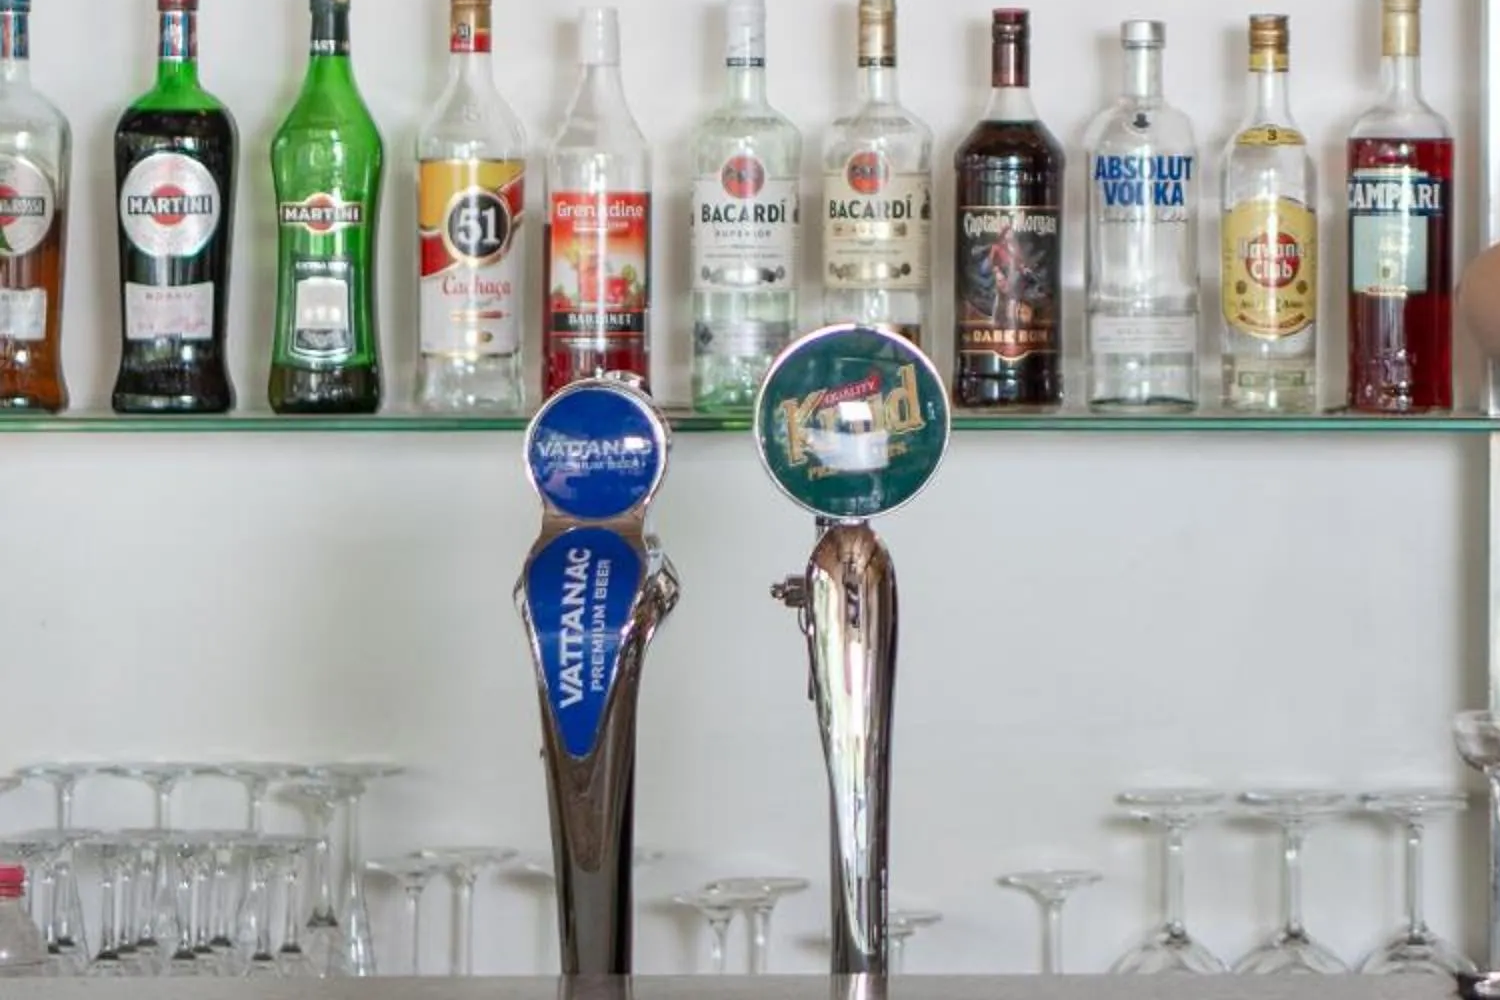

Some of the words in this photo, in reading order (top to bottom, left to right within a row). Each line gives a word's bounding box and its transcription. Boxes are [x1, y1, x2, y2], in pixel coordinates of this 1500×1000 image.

[1094, 154, 1193, 181] ABSOLUT
[129, 196, 212, 214] MARTINI
[285, 206, 360, 221] MARTINI
[557, 200, 645, 218] Grendine
[456, 207, 501, 245] 51
[963, 210, 1009, 238] Captain
[568, 313, 632, 325] BARINET
[782, 363, 927, 467] Kd
[536, 437, 653, 458] VATTAN
[595, 559, 612, 601] BEER
[559, 546, 592, 710] VATTANAC
[591, 607, 606, 692] PREMIUM
